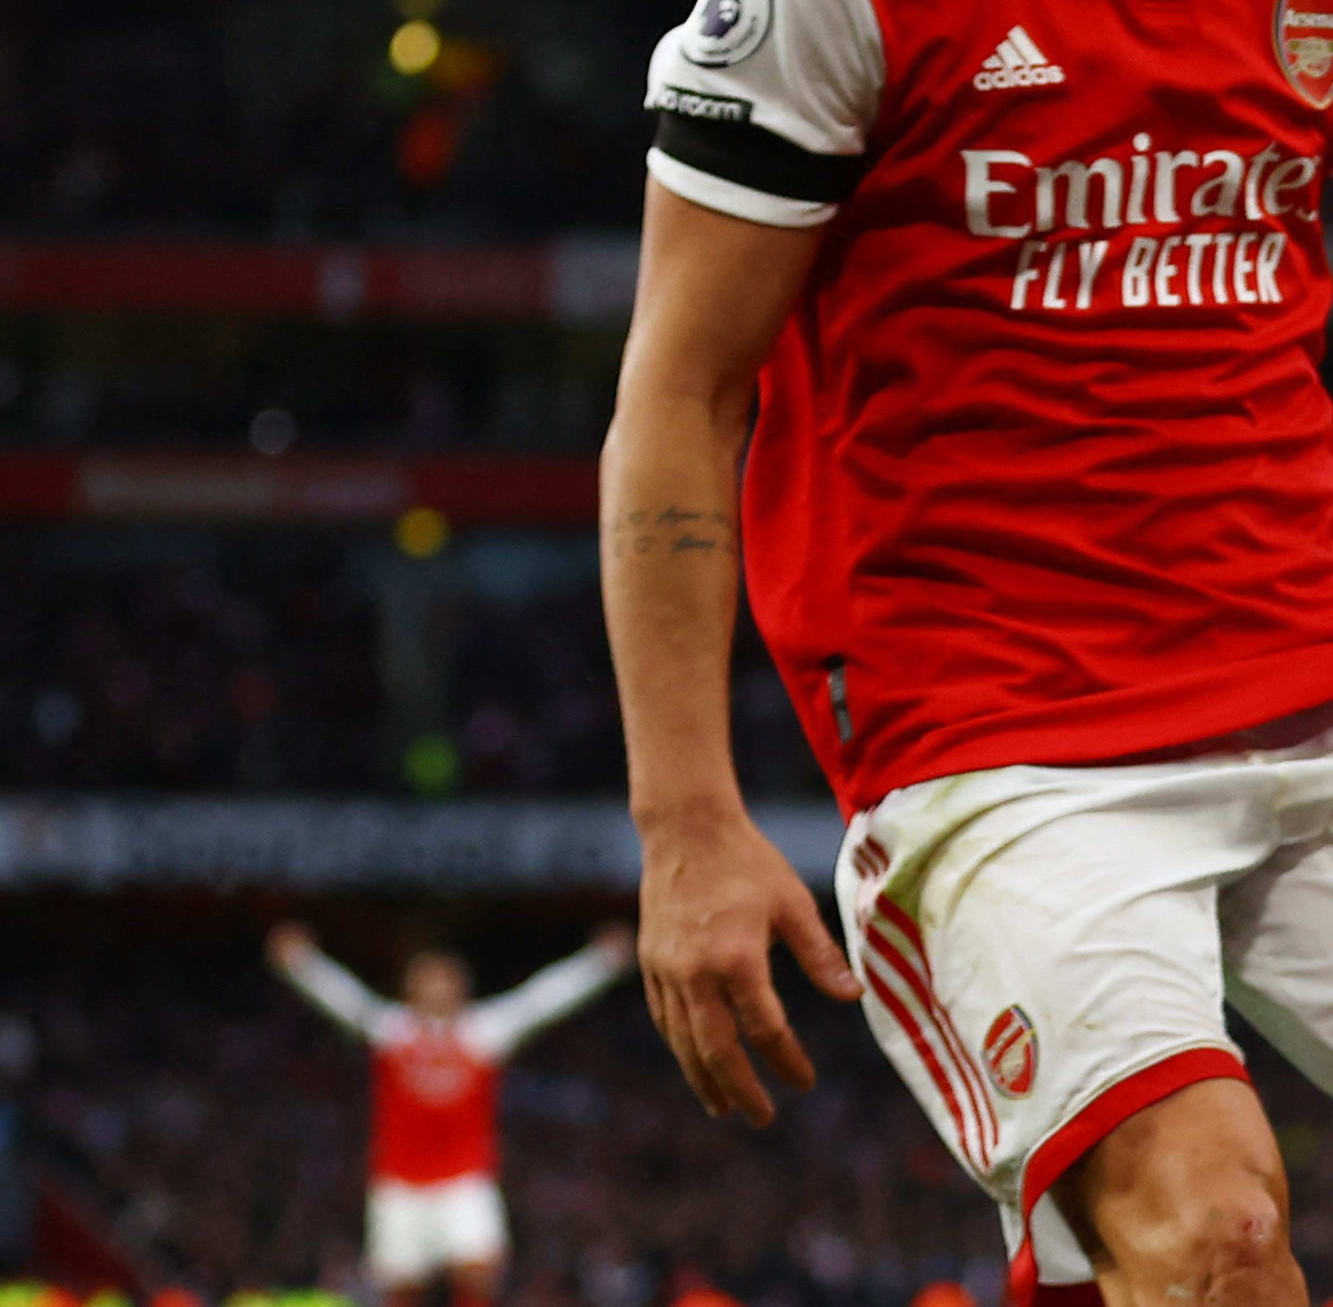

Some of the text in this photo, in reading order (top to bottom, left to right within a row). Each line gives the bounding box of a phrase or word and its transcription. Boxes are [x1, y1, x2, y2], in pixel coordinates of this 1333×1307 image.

[972, 64, 1065, 91] adidas
[1010, 232, 1287, 311] FLY BETTER
